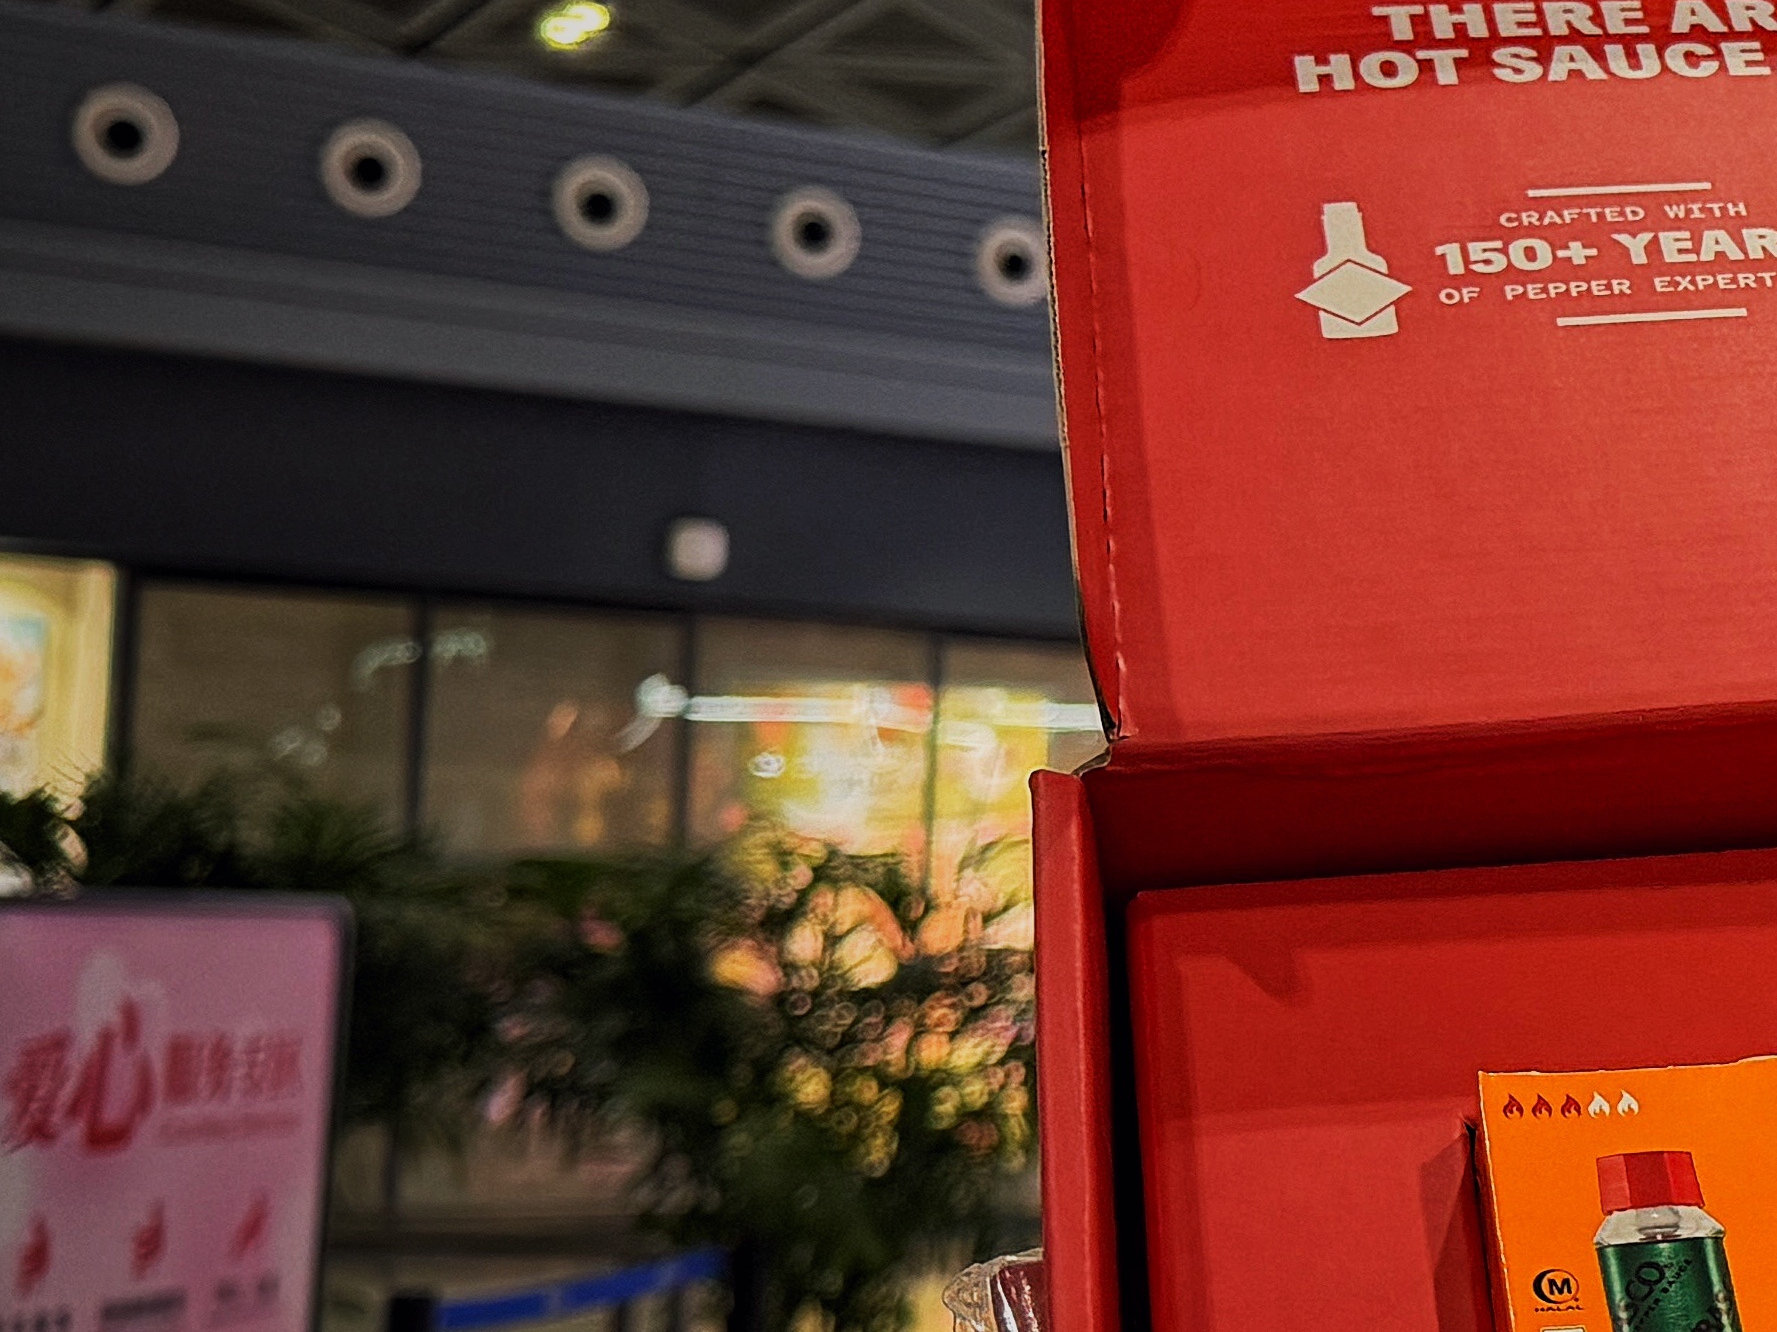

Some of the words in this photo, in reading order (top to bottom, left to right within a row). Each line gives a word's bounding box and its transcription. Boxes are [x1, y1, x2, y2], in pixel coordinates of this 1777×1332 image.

[1372, 0, 1648, 42] THERE
[1294, 49, 1471, 93] HOT
[1499, 205, 1645, 228] CRAFTED
[1665, 199, 1747, 220] WITH
[1434, 237, 1597, 276] 150+
[1438, 286, 1480, 305] OF
[1505, 277, 1631, 302] PEPPER
